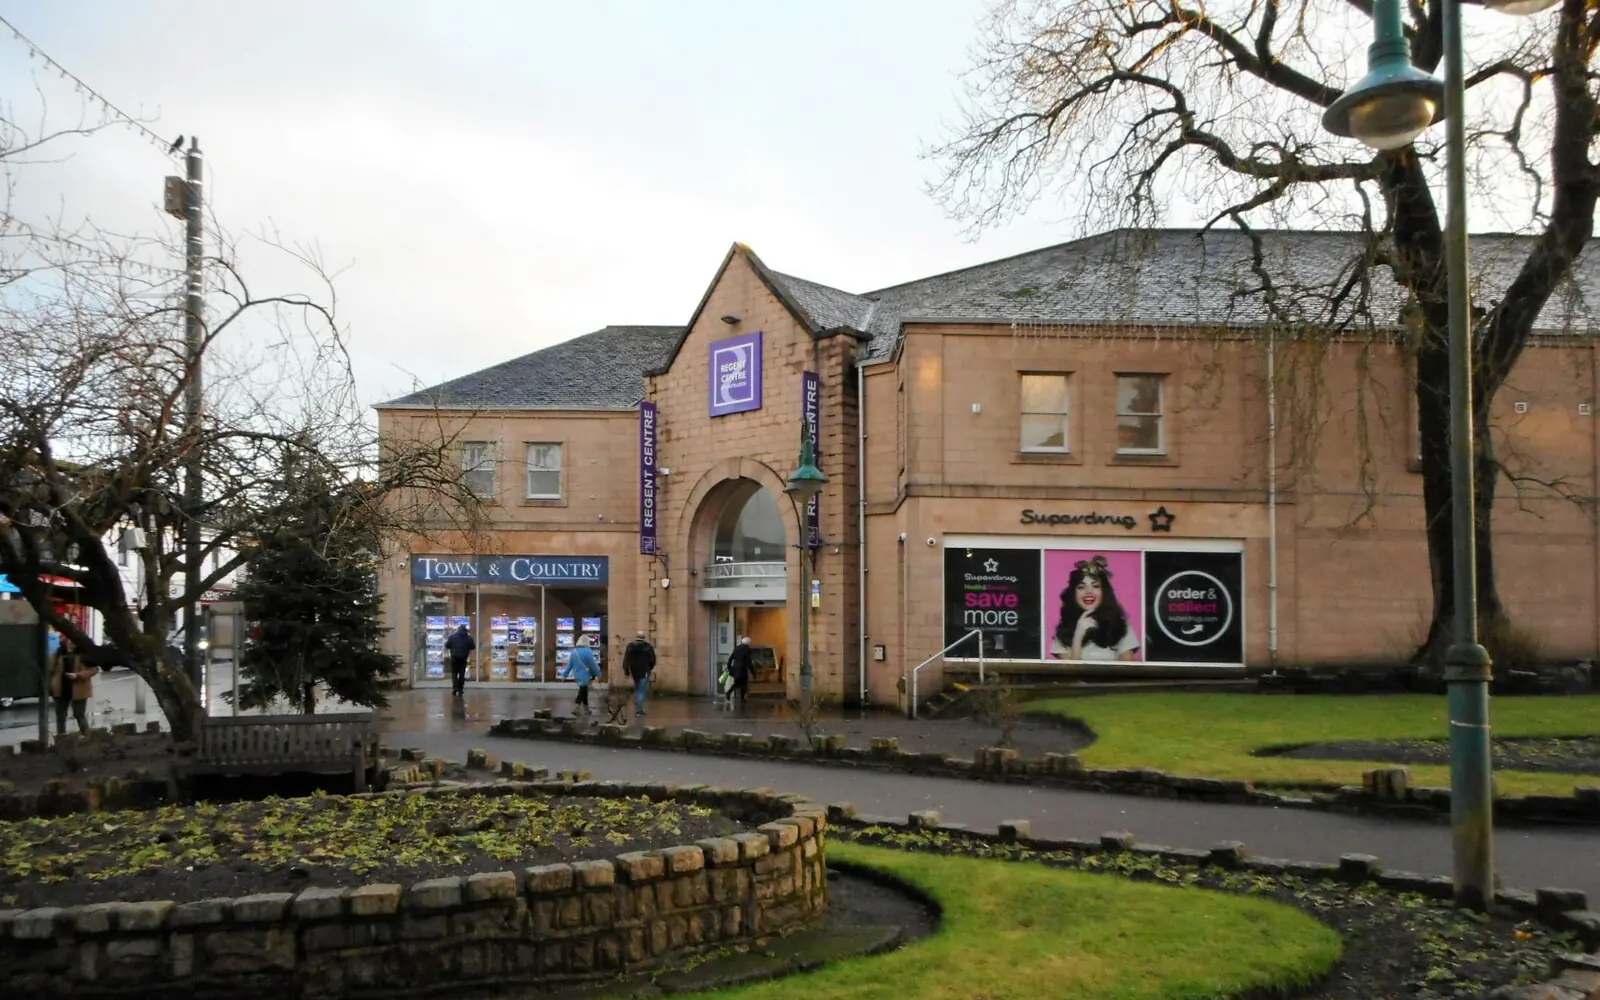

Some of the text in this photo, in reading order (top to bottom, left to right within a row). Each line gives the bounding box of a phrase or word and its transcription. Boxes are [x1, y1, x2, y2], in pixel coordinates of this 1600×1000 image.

[721, 359, 746, 373] REGENT
[721, 370, 747, 383] CENTRE
[643, 409, 653, 528] REGENT CENTRE
[1020, 509, 1137, 529] Superdrug
[488, 560, 500, 576] &
[964, 573, 1018, 583] Superdrug
[965, 592, 1019, 608] save
[1167, 588, 1217, 599] order &
[1168, 600, 1217, 612] collect
[964, 609, 1019, 625] more
